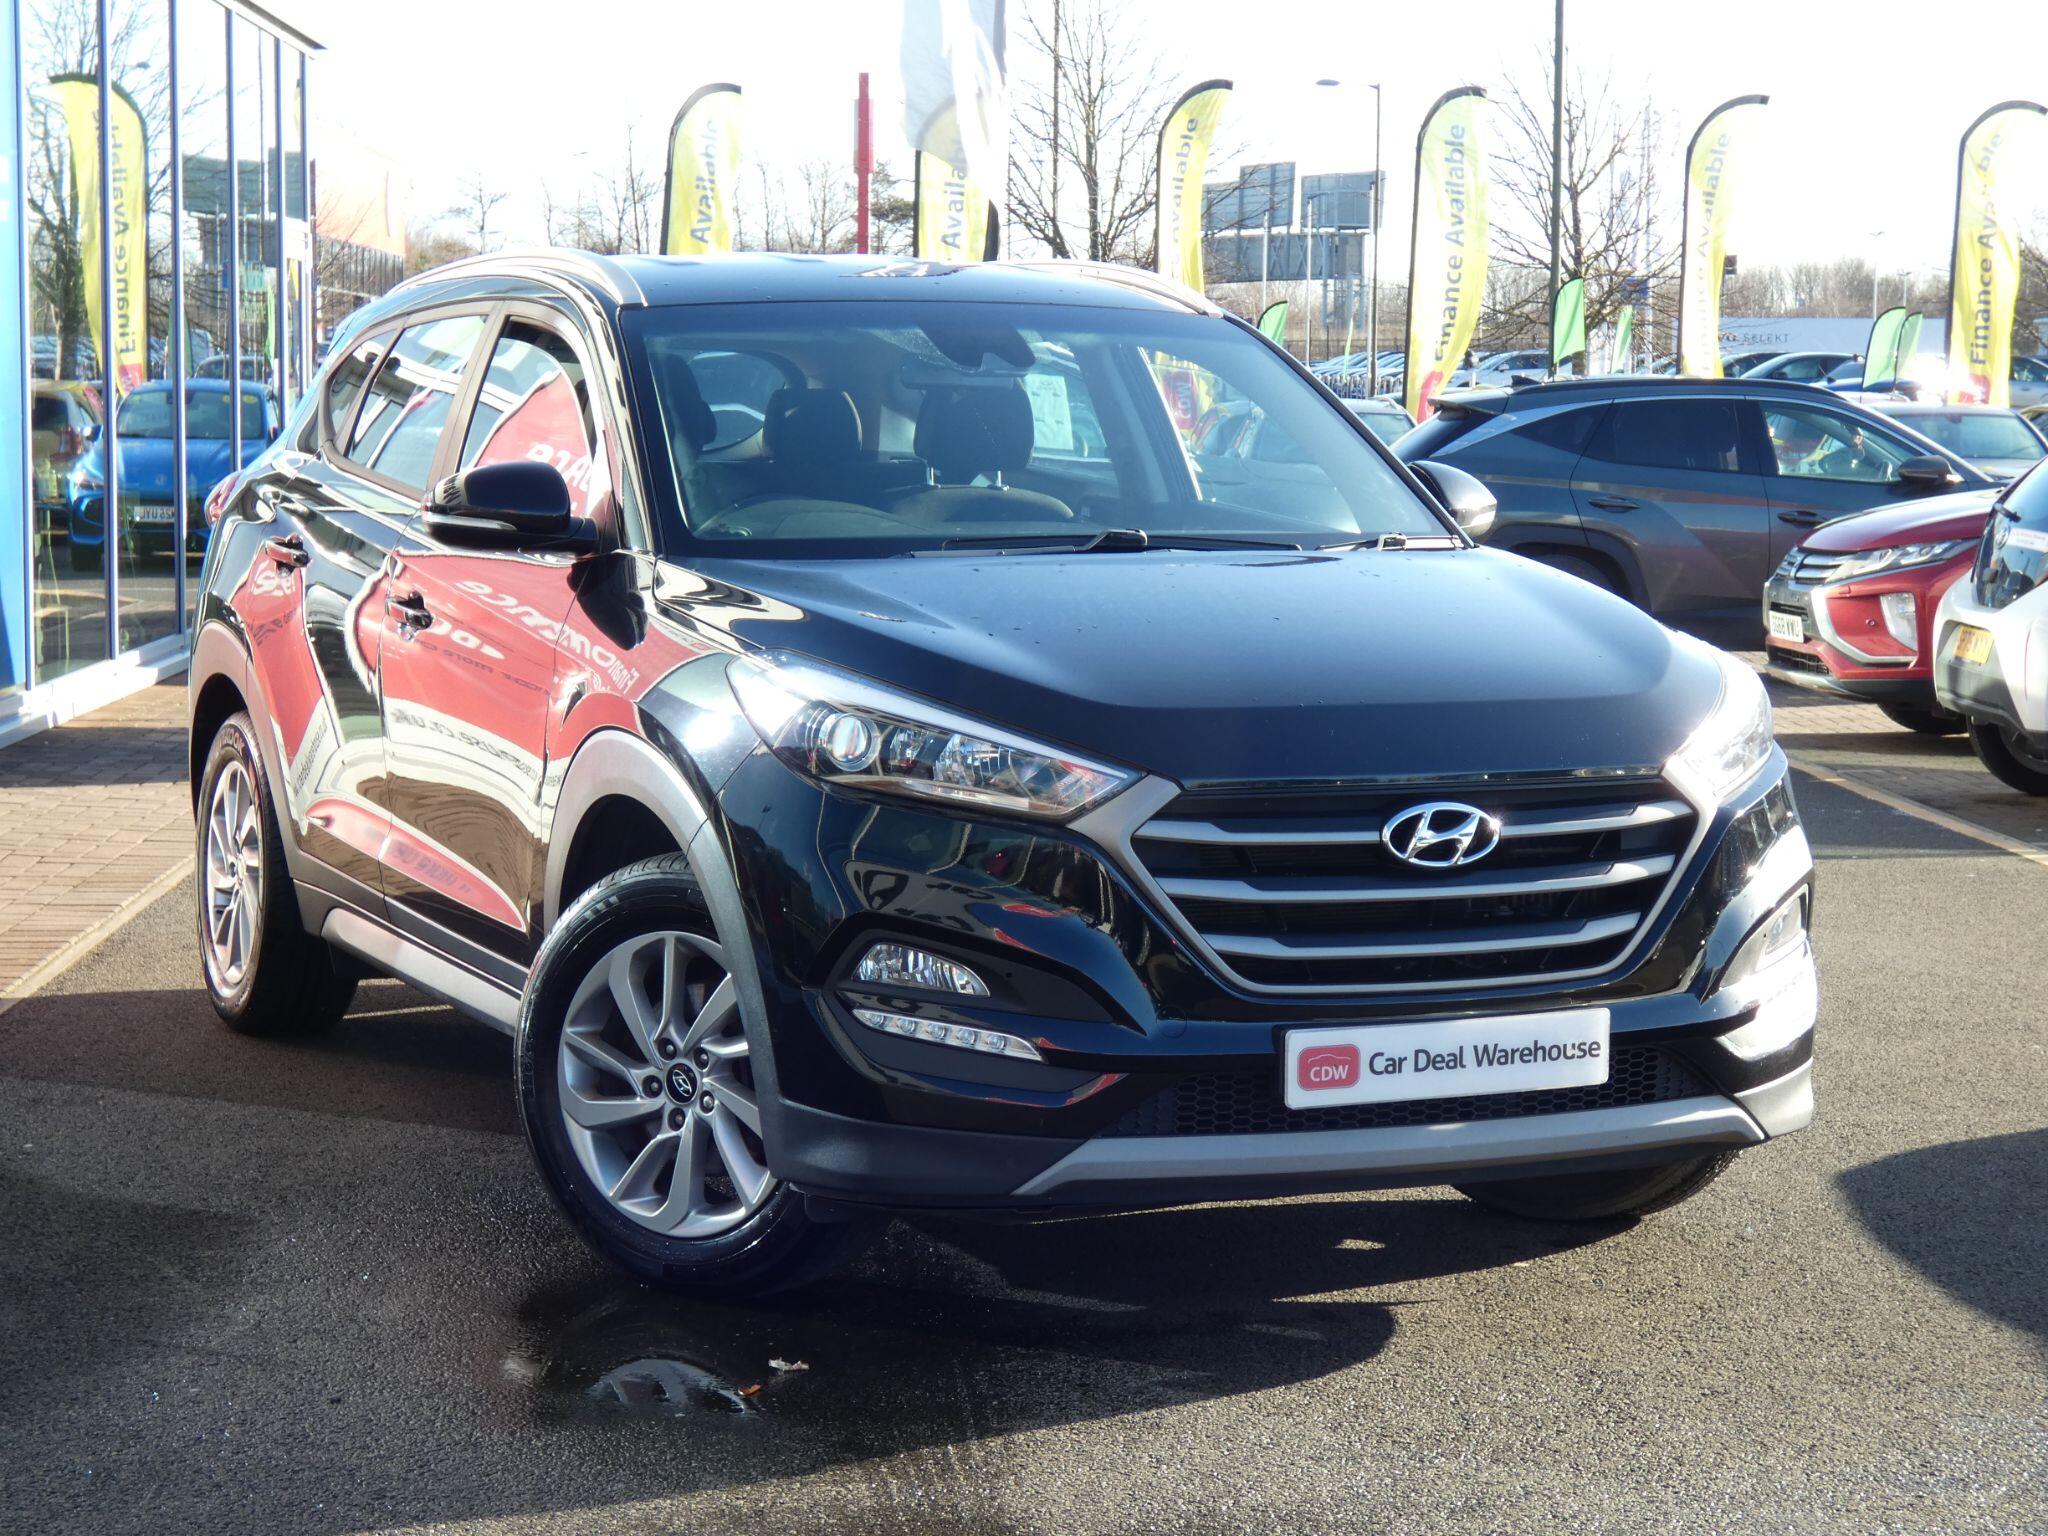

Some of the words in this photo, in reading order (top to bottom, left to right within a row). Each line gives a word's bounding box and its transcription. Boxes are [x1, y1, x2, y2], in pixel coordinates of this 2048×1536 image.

[940, 166, 967, 250] Availa
[1444, 123, 1466, 248] Available
[1696, 133, 1730, 258] Available
[1977, 133, 2001, 251] Avable
[1434, 253, 1463, 362] Finance
[1743, 333, 1789, 344] SELEKT
[1969, 258, 1993, 365] Finance
[1310, 1064, 1349, 1082] CDW
[1369, 1052, 1407, 1076] Car
[1413, 1046, 1466, 1073] Deal
[1473, 1040, 1601, 1068] Warehouse
